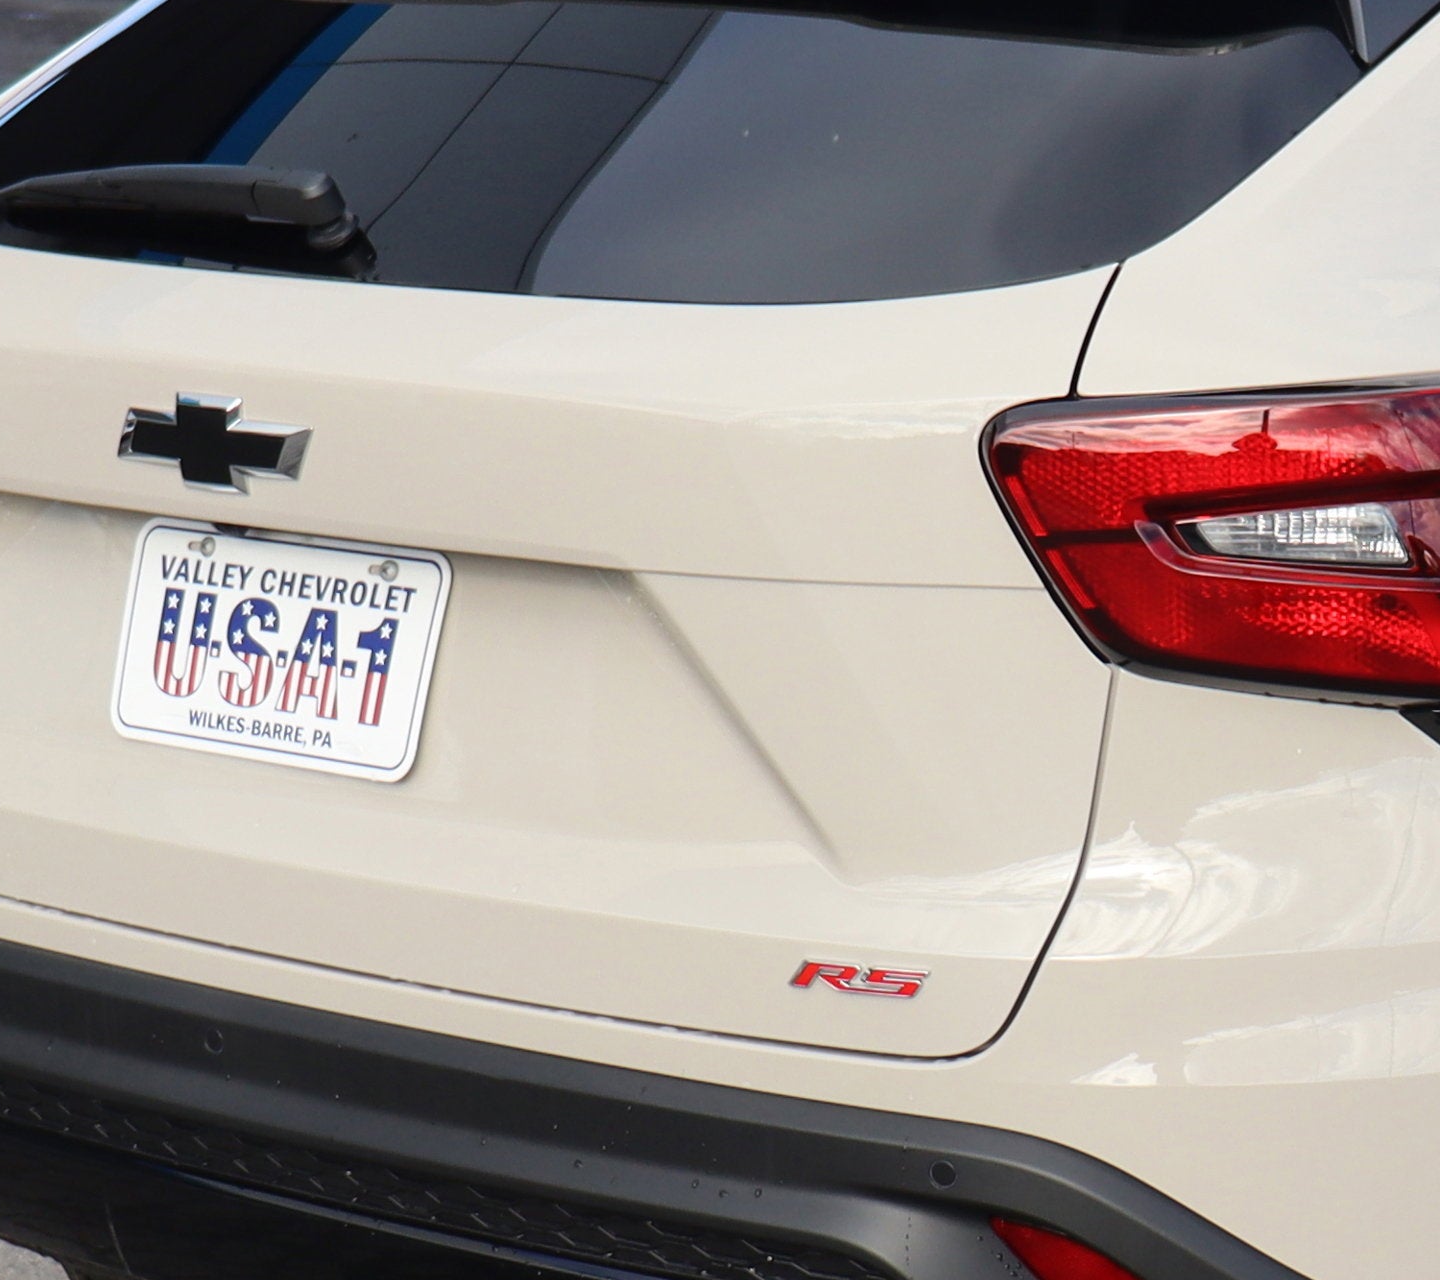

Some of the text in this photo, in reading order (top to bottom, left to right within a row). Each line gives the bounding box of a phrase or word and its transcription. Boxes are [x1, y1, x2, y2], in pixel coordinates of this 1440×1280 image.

[160, 554, 418, 614] VALLEY CHEVROLET
[188, 709, 333, 749] WILKES-BARRE, PA
[789, 960, 932, 999] RS
